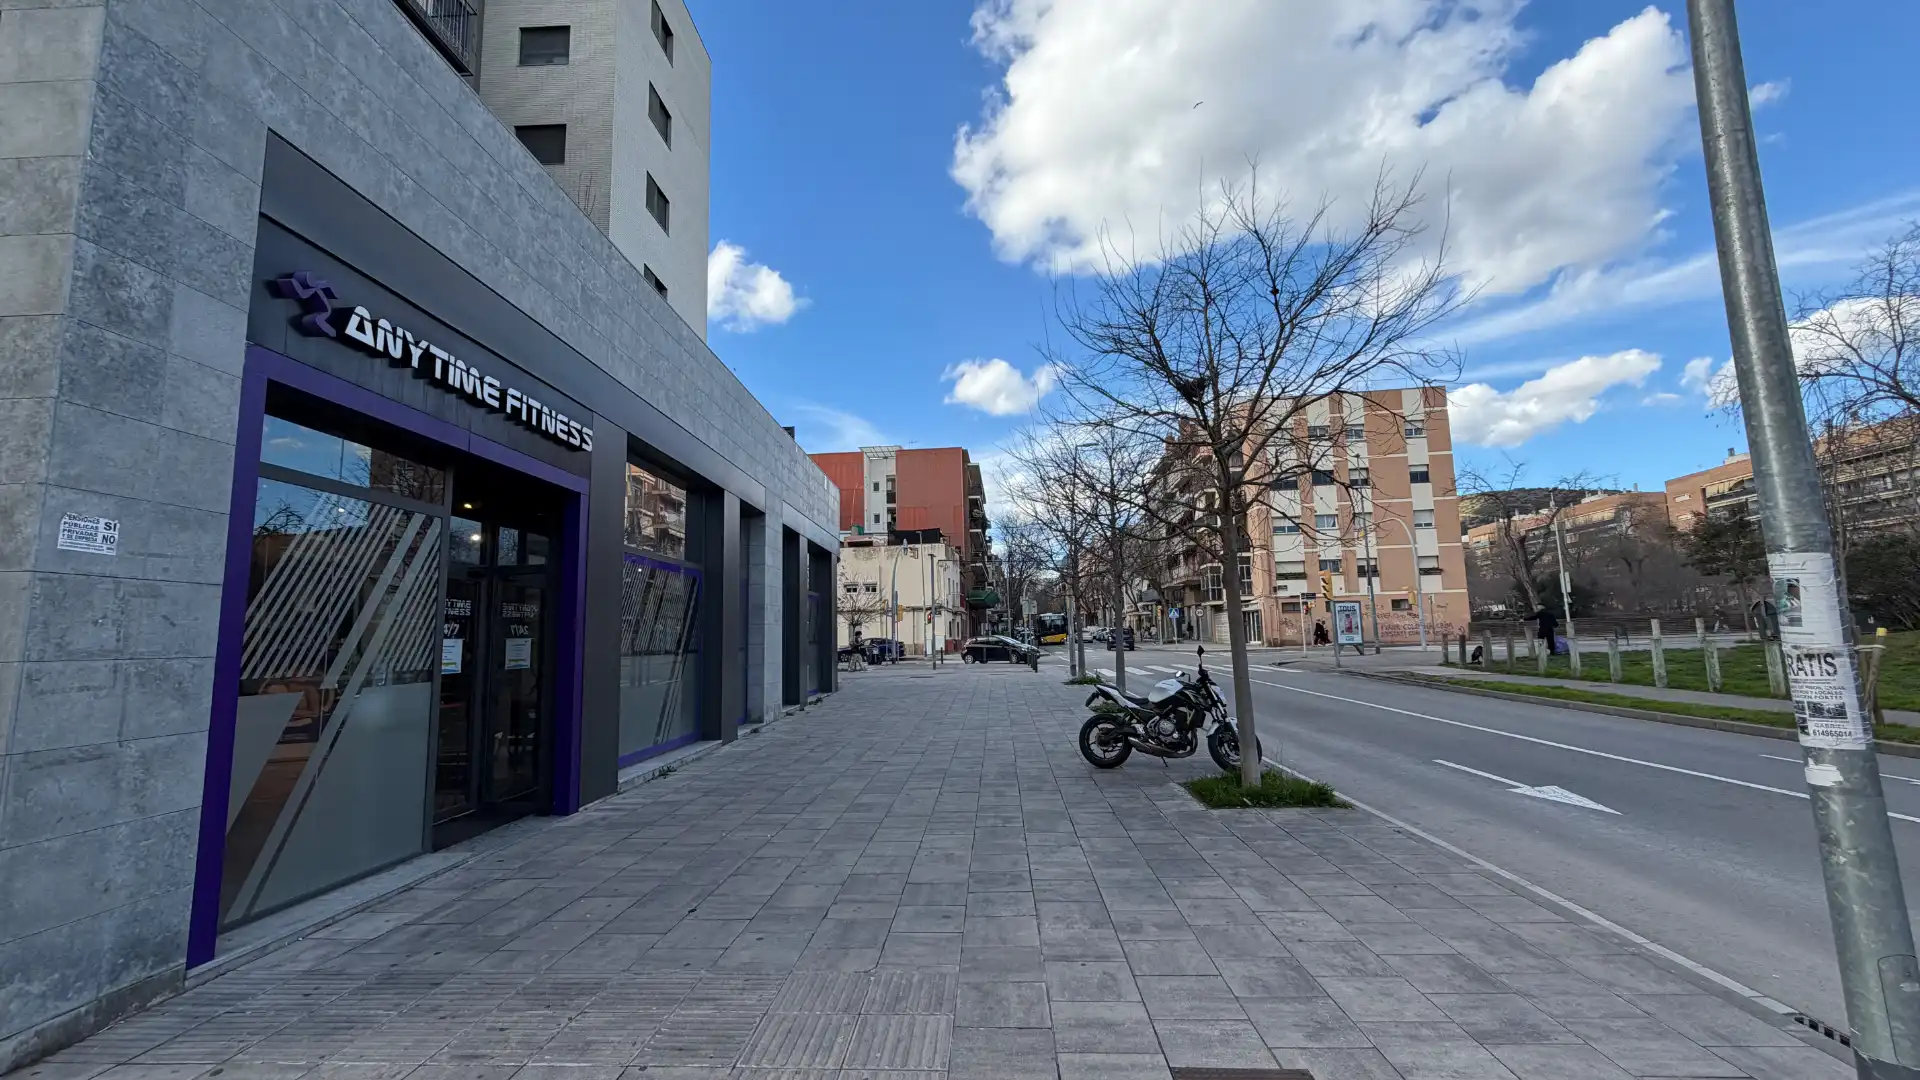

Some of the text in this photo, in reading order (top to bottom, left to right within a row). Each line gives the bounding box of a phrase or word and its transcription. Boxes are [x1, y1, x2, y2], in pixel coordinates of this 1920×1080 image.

[345, 305, 593, 452] ANYTIME FITNESS
[63, 521, 99, 530] PÚBLICAS
[62, 528, 98, 537] PRIVADAS
[102, 534, 116, 544] NO
